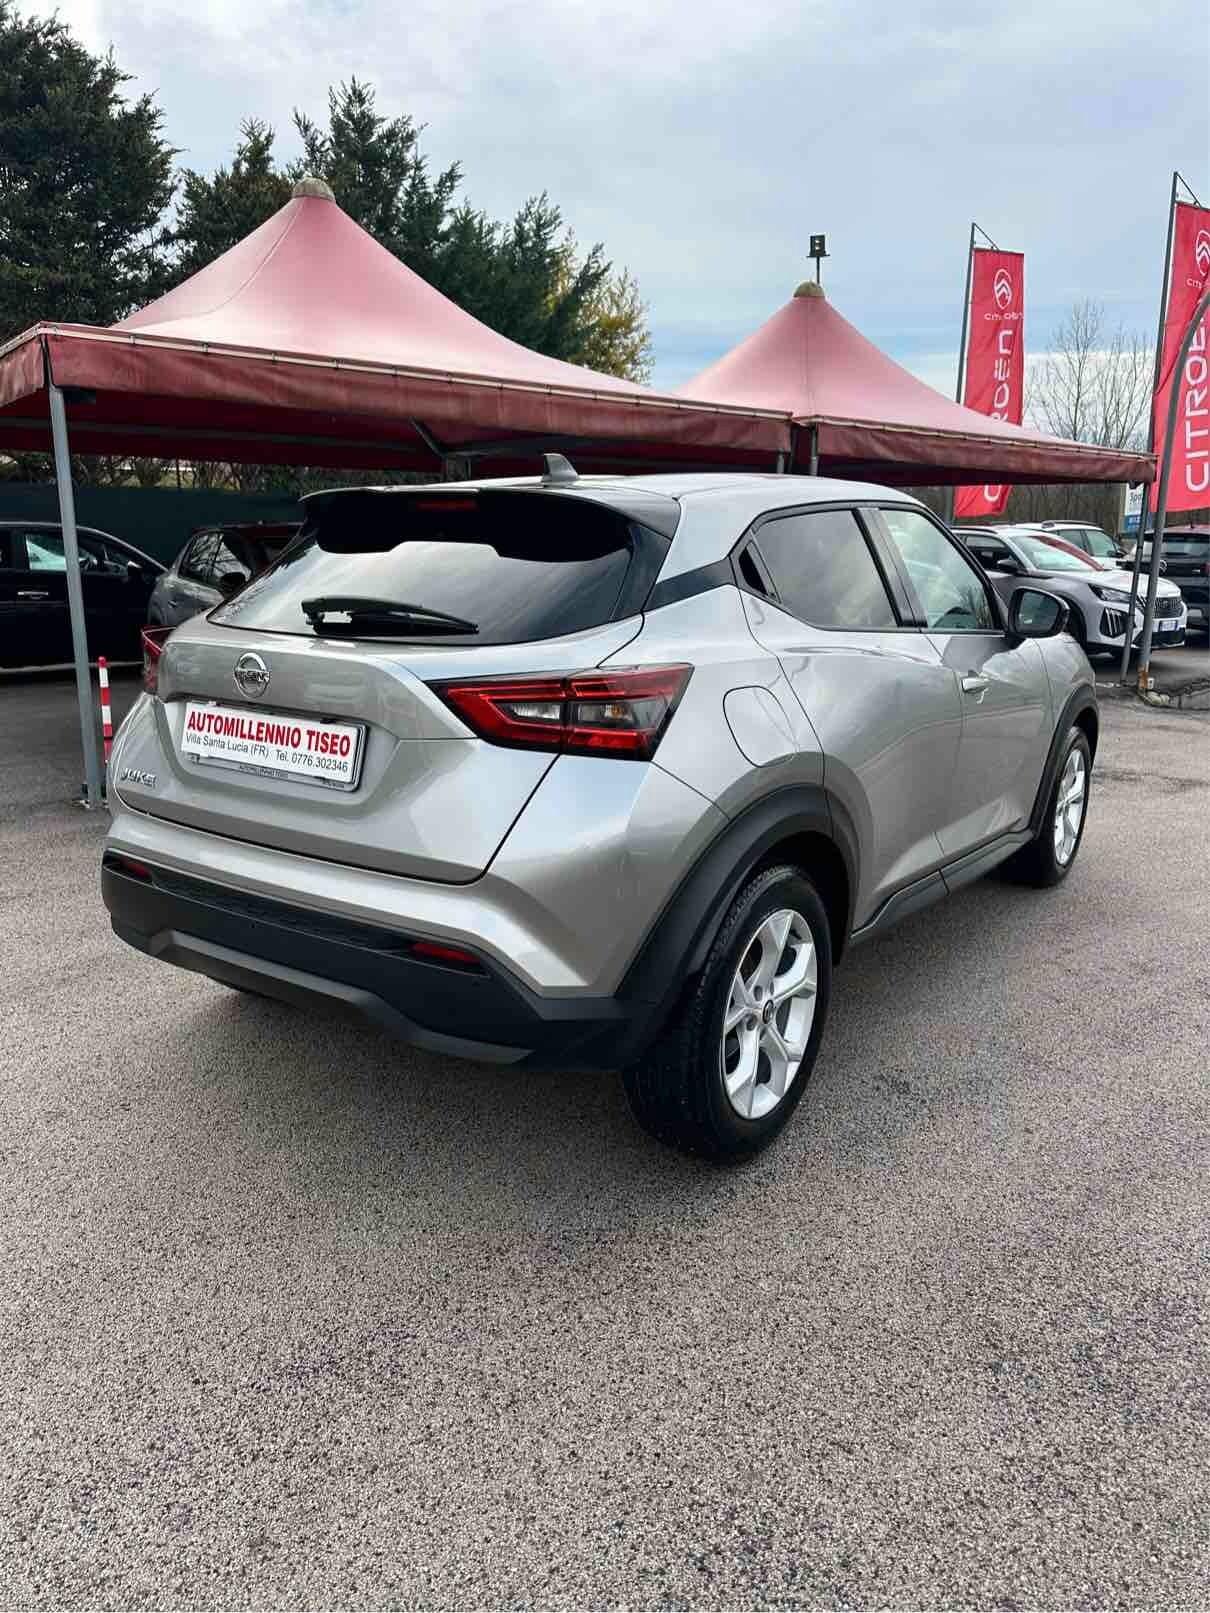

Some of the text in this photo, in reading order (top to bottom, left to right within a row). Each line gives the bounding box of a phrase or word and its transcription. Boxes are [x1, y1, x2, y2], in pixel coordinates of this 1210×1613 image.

[187, 711, 351, 757] AUTOMILLENNIO TISEO
[203, 735, 226, 750] Santa
[227, 740, 249, 753] Lucia
[250, 743, 269, 759] (FR)
[291, 752, 349, 773] 0776.302346
[121, 767, 157, 788] JUKE
